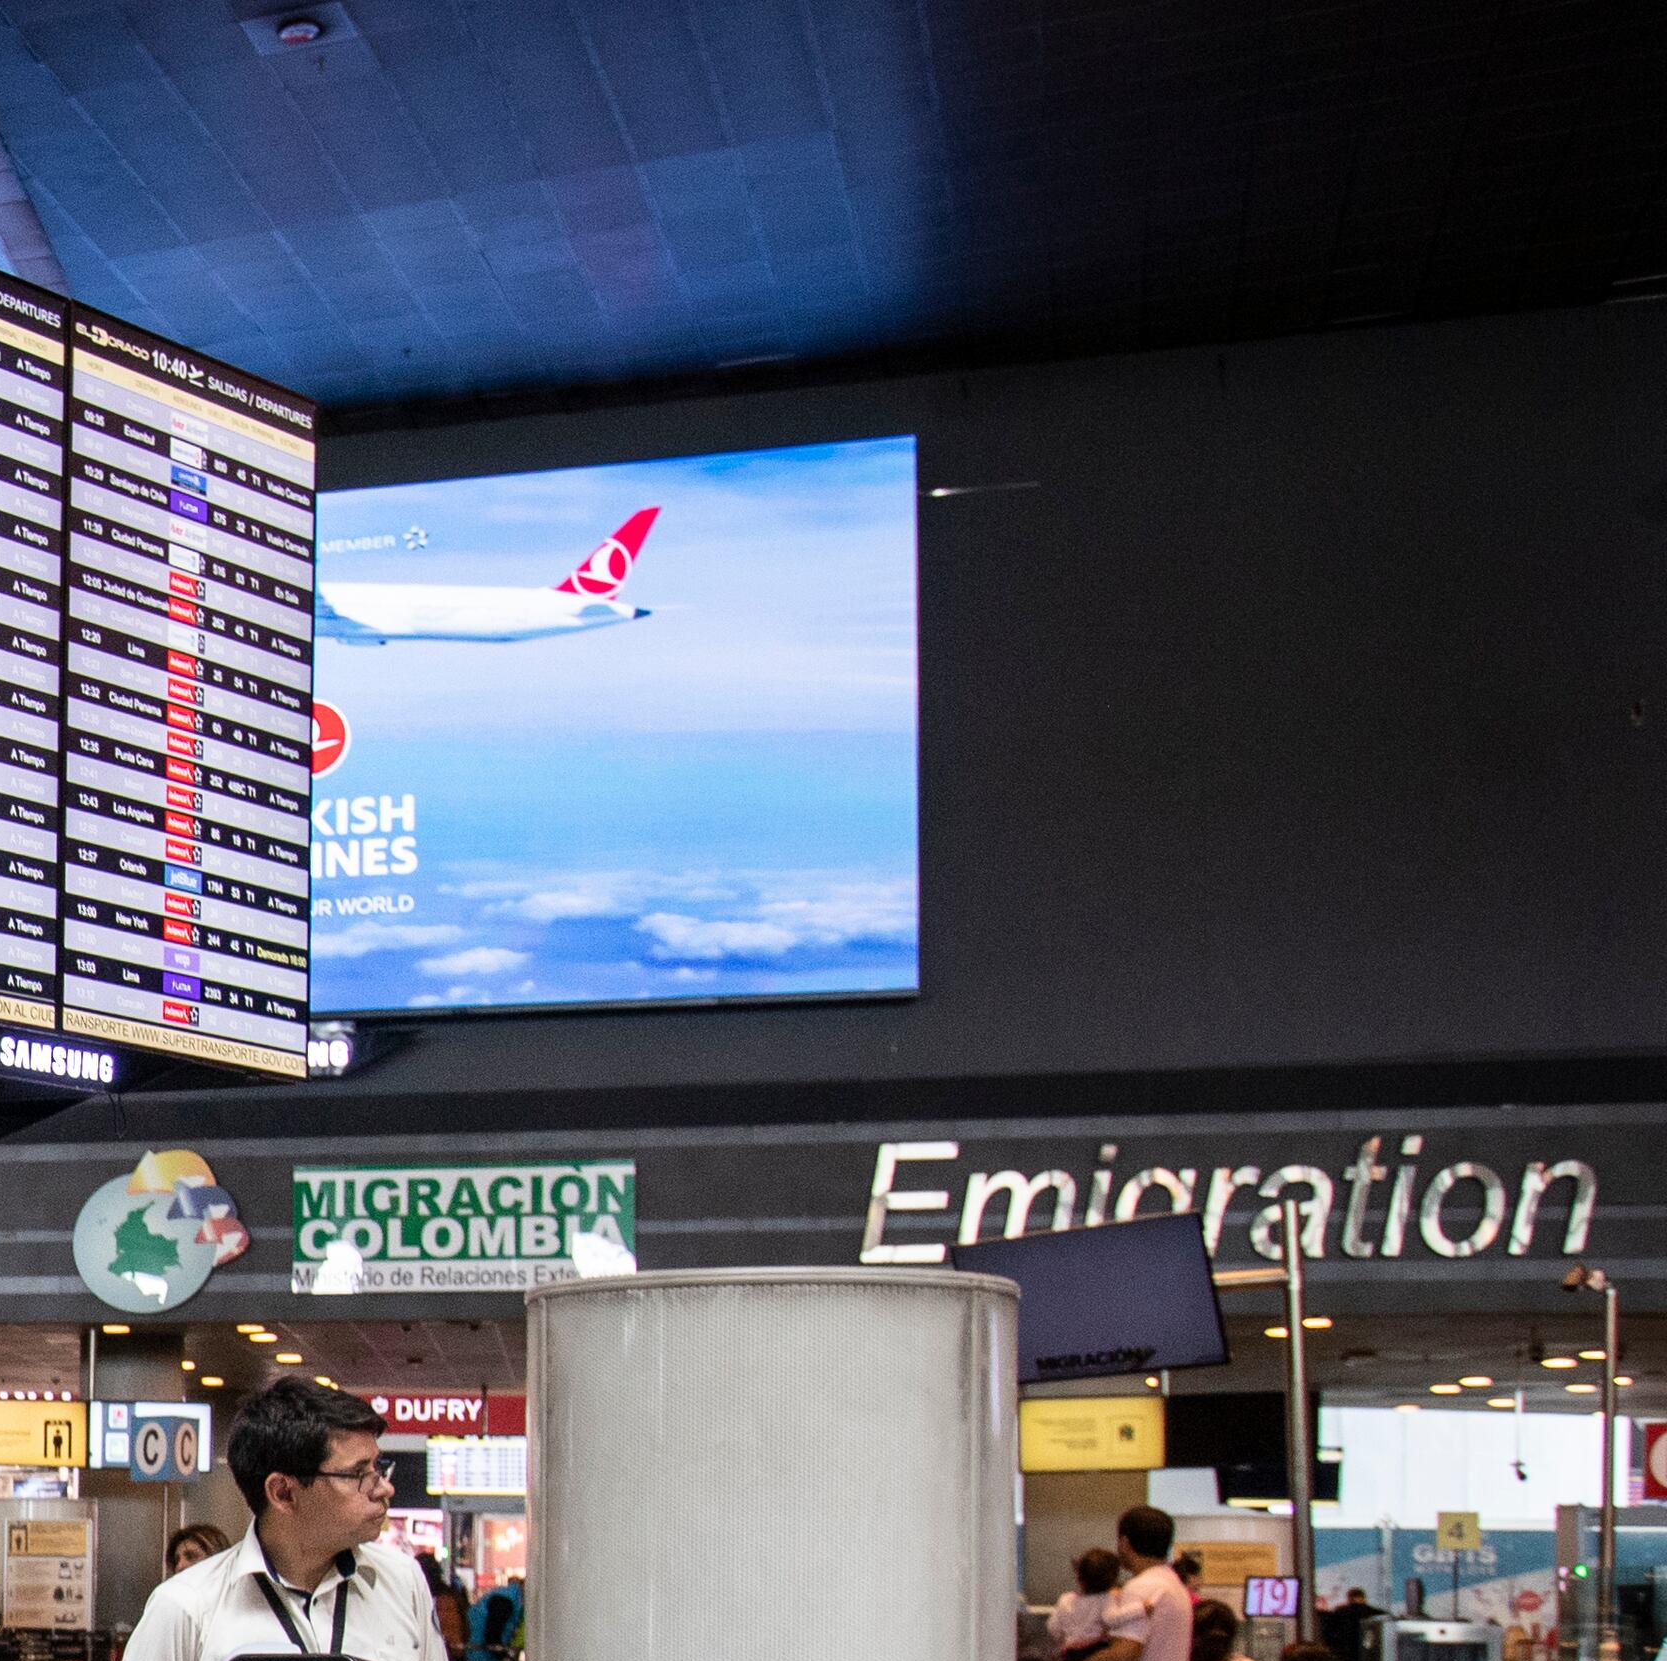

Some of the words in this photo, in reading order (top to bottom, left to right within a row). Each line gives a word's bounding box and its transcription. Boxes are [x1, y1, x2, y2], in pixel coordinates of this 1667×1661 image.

[151, 349, 187, 379] 10:40
[207, 375, 247, 402] SALIDAS
[255, 395, 312, 429] DEPARTURES
[112, 801, 127, 815] Los
[126, 805, 154, 823] Angeles
[118, 857, 146, 875] Orlando
[336, 895, 414, 916] WORLD
[115, 911, 132, 926] New
[131, 915, 149, 930] York
[122, 968, 140, 983] Lima
[7, 1002, 27, 1018] AL
[0, 1035, 114, 1083] SAMSUNG
[391, 1268, 413, 1286] de
[420, 1266, 527, 1285] Relaciones
[395, 1398, 482, 1422] DUFRY
[143, 1428, 159, 1466] C
[181, 1429, 193, 1463] C
[1254, 1579, 1287, 1616] 19
